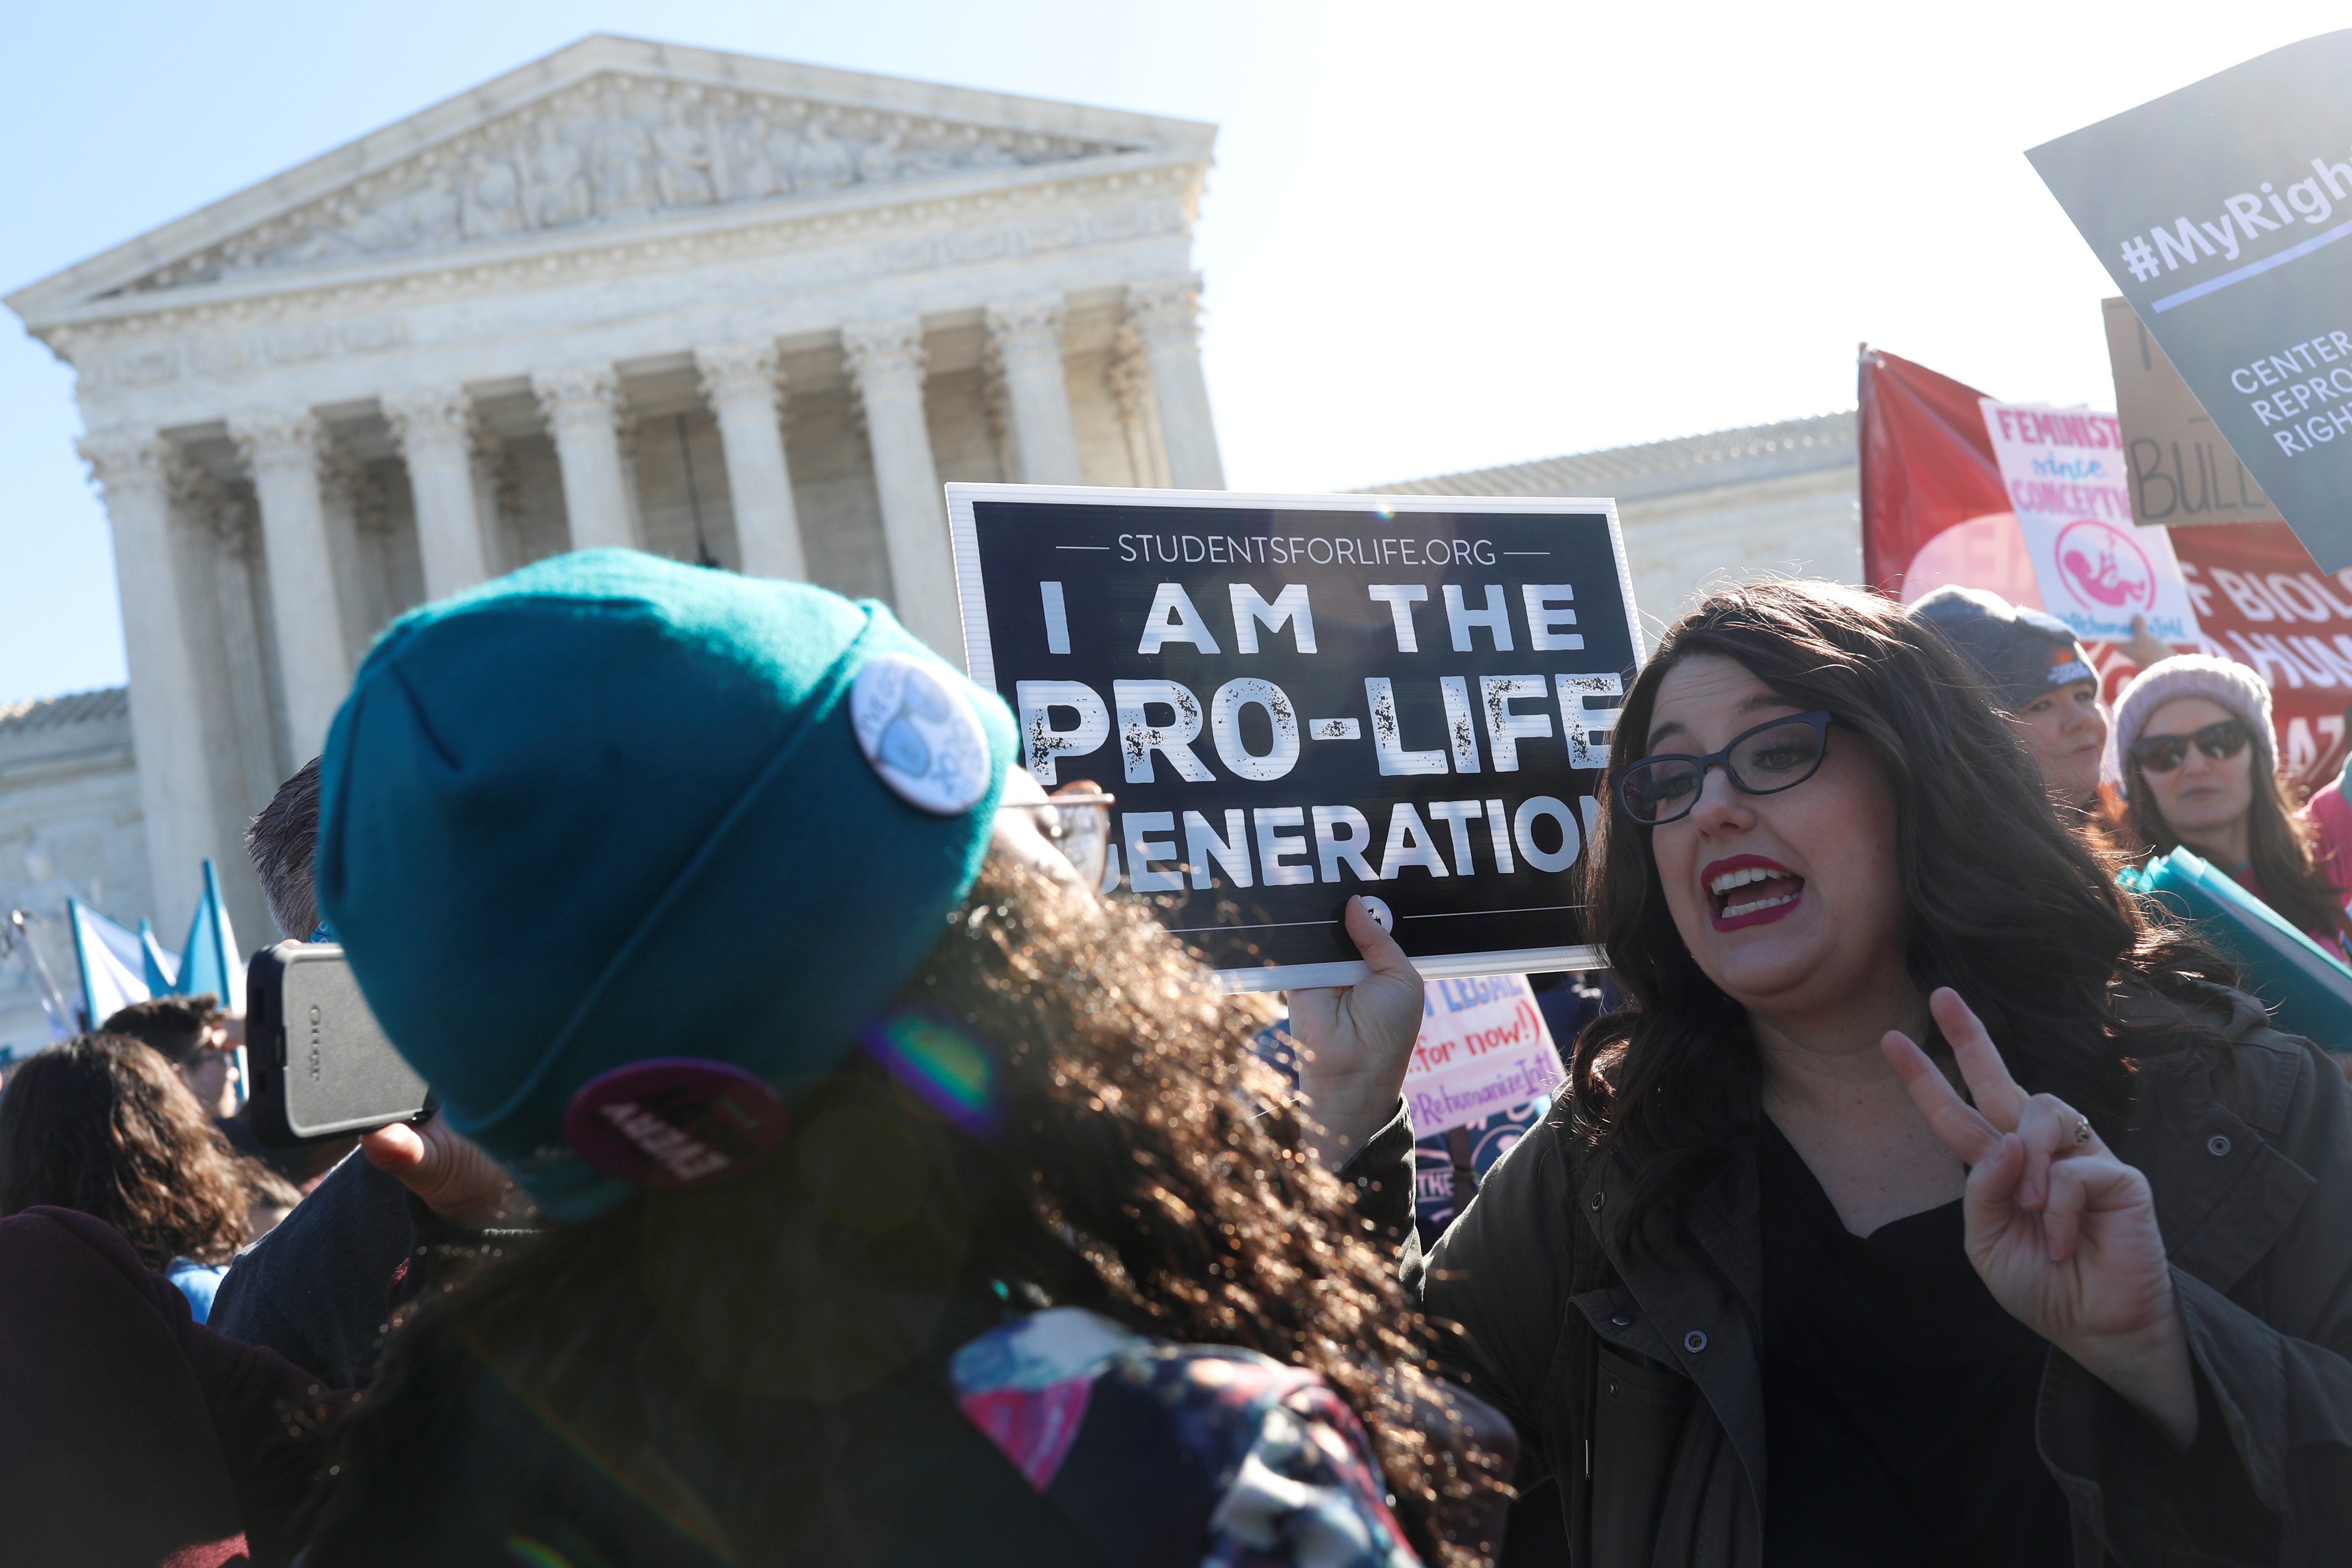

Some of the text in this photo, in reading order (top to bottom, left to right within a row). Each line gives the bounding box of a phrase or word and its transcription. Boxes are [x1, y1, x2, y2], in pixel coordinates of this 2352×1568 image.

[2120, 146, 2352, 283] #MyRigh
[2231, 330, 2352, 394] CENTER
[2251, 363, 2352, 427] REPRO
[2273, 401, 2352, 457] RIGH
[1118, 534, 1496, 566] STUDENTSFORLIFE.ORG
[1040, 581, 1585, 655] I AM THE
[2208, 566, 2352, 623] BIOL
[1016, 672, 1624, 786] PRO-LIFE
